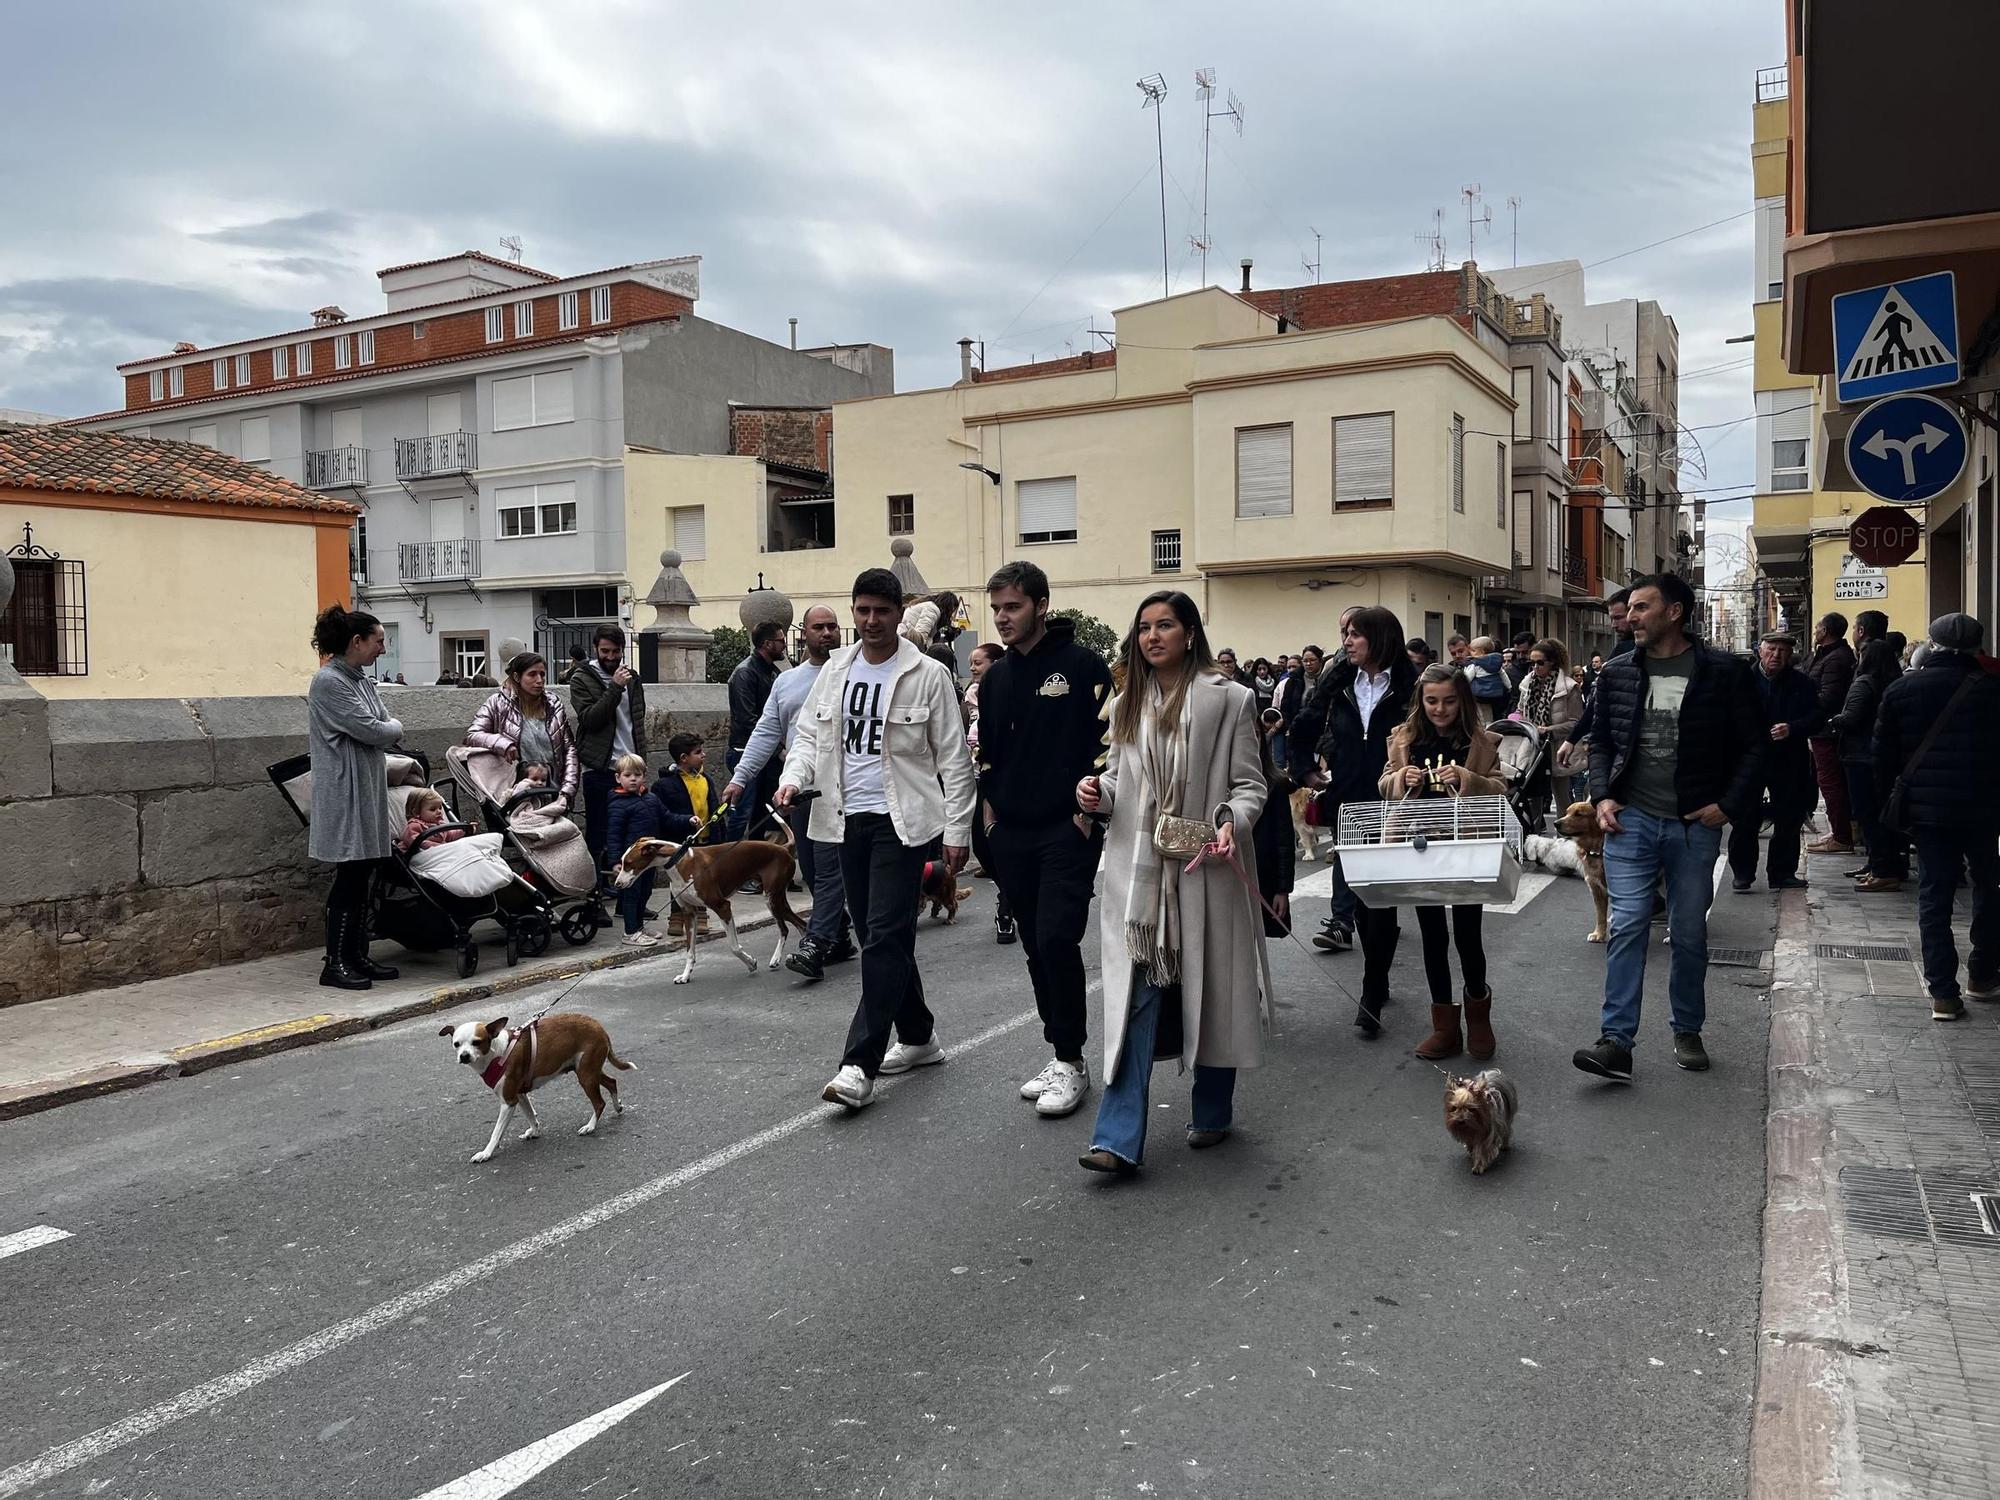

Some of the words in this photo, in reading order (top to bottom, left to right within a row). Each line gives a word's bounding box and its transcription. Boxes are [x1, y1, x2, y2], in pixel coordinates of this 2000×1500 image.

[1855, 527, 1915, 547] STOP
[1836, 580, 1872, 588] centre
[845, 719, 883, 755] ME
